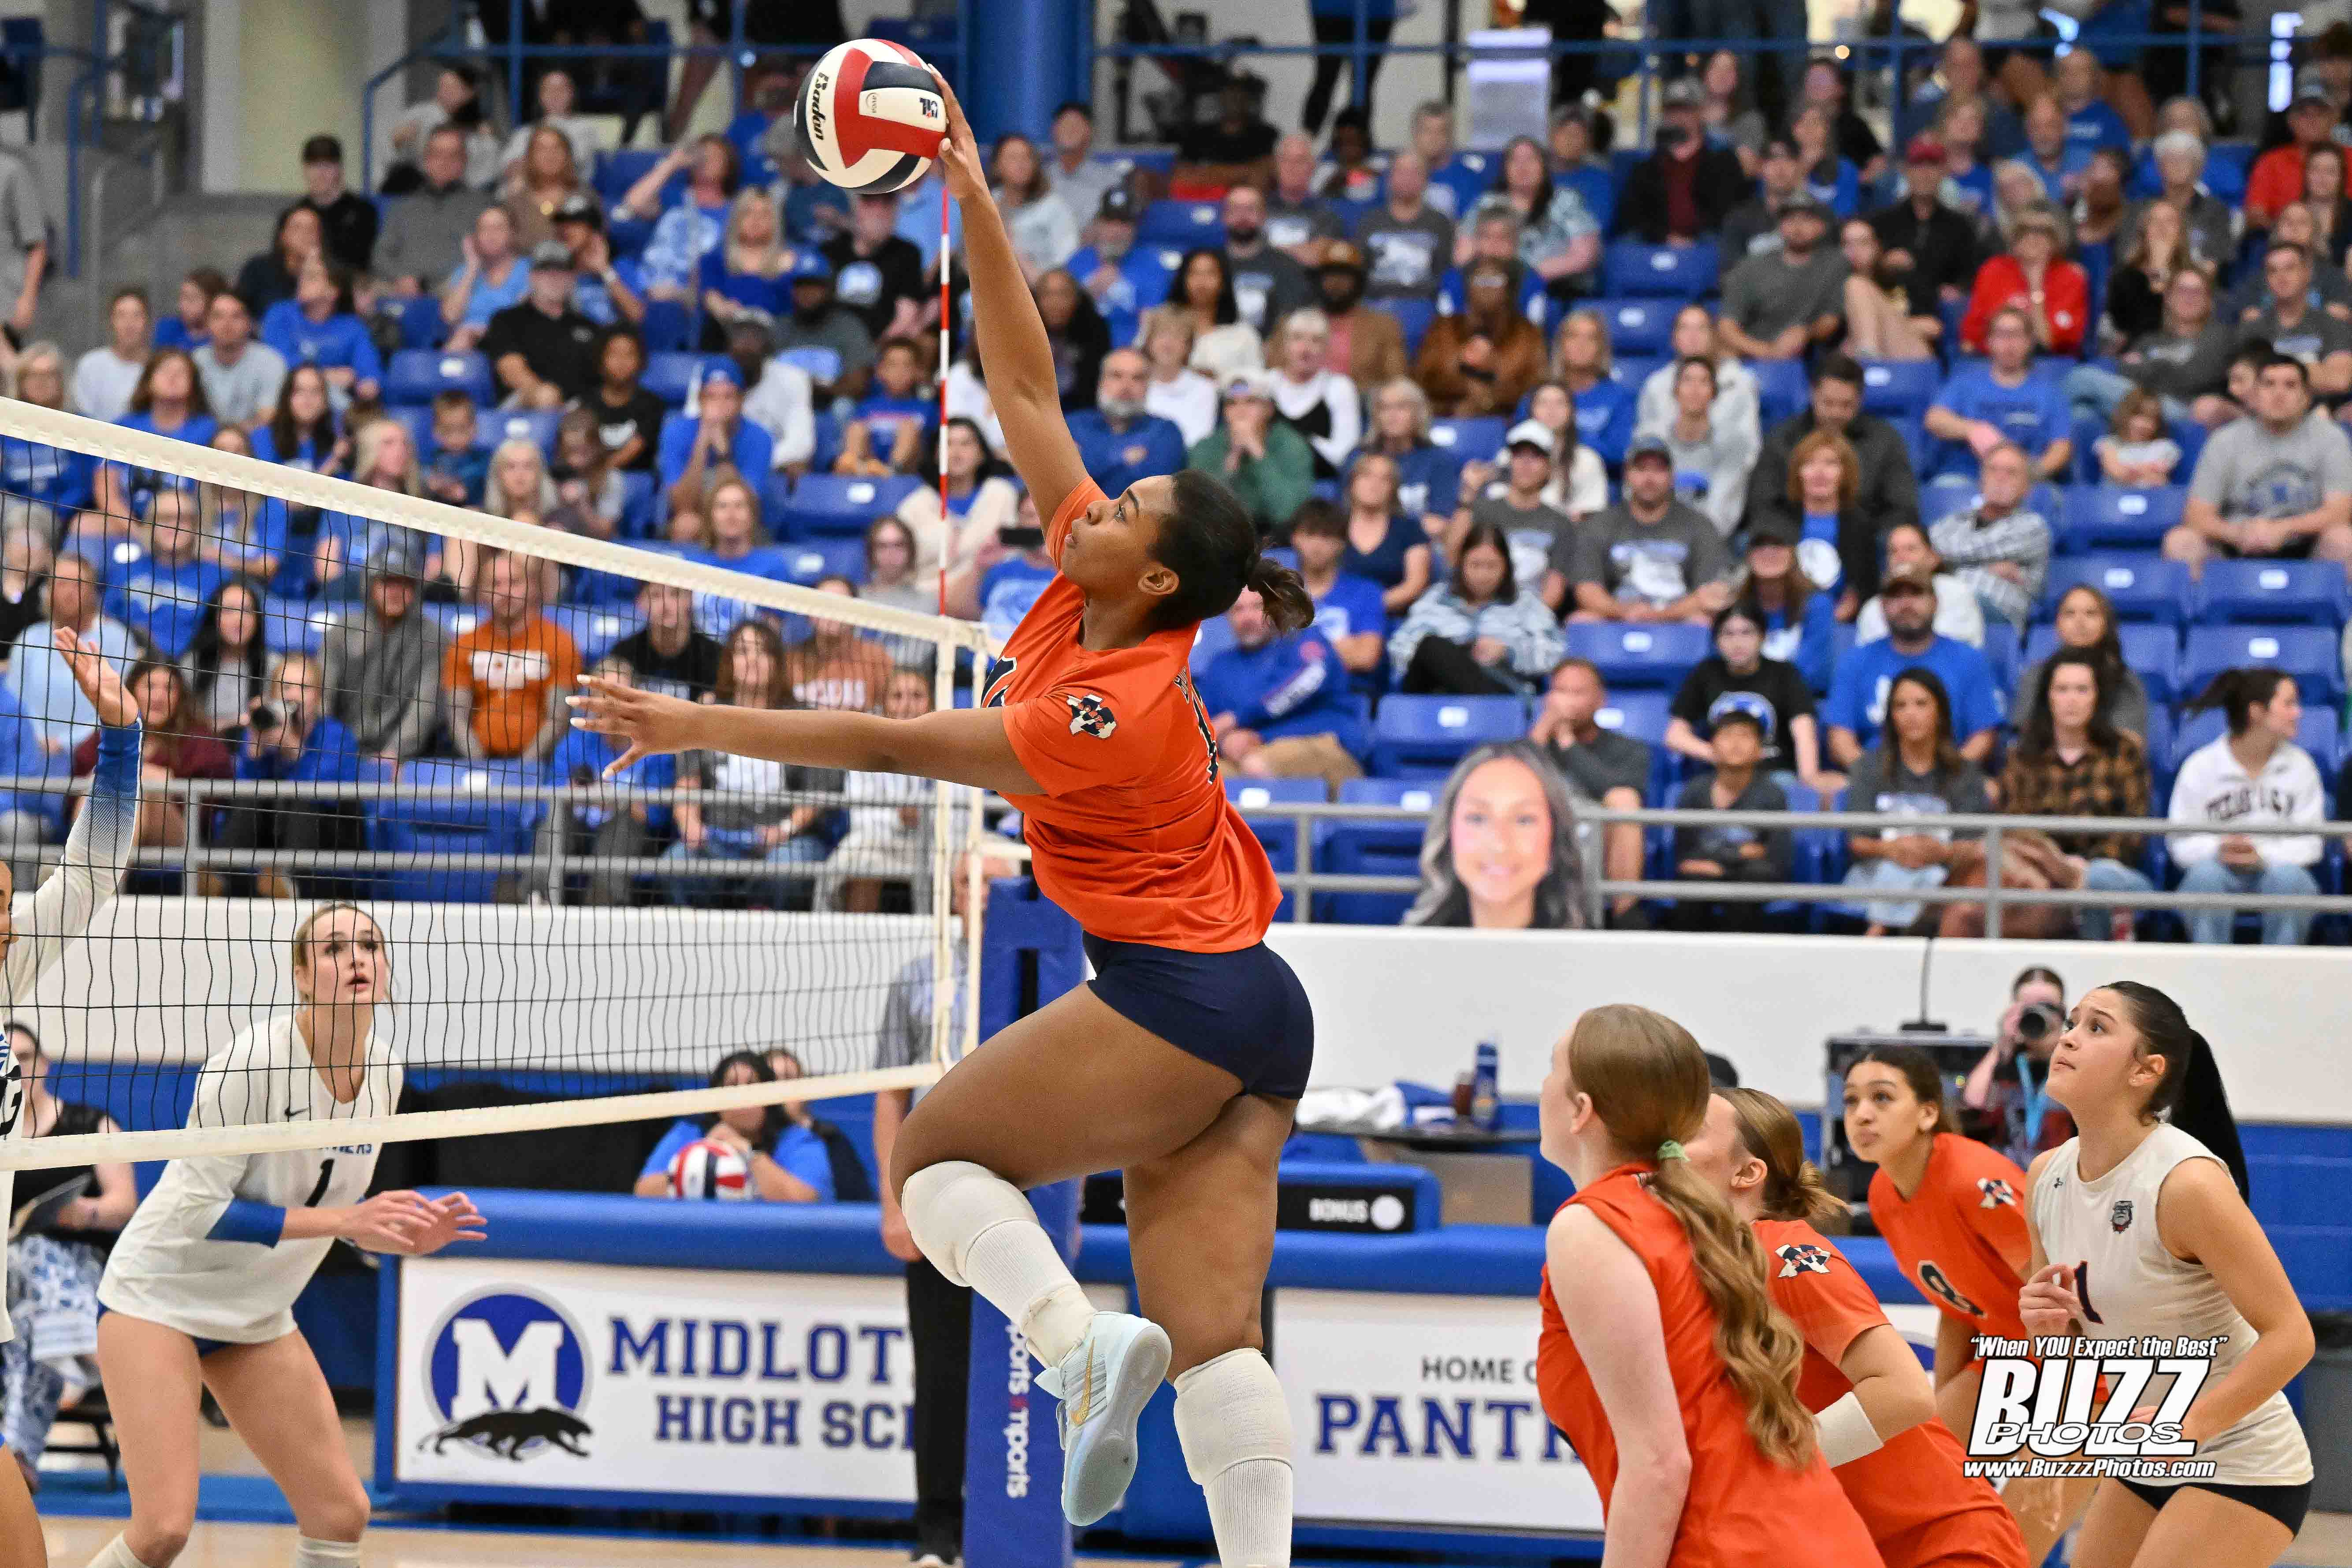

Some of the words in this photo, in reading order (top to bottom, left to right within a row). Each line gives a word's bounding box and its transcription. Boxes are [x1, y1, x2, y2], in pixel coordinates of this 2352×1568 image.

[304, 1158, 335, 1208] 1
[606, 1316, 910, 1383] MIDLOT
[1006, 1321, 1033, 1395] ports
[1422, 1357, 1514, 1383] HOME
[655, 1395, 799, 1446] HIGH
[1315, 1393, 1582, 1462] PANT
